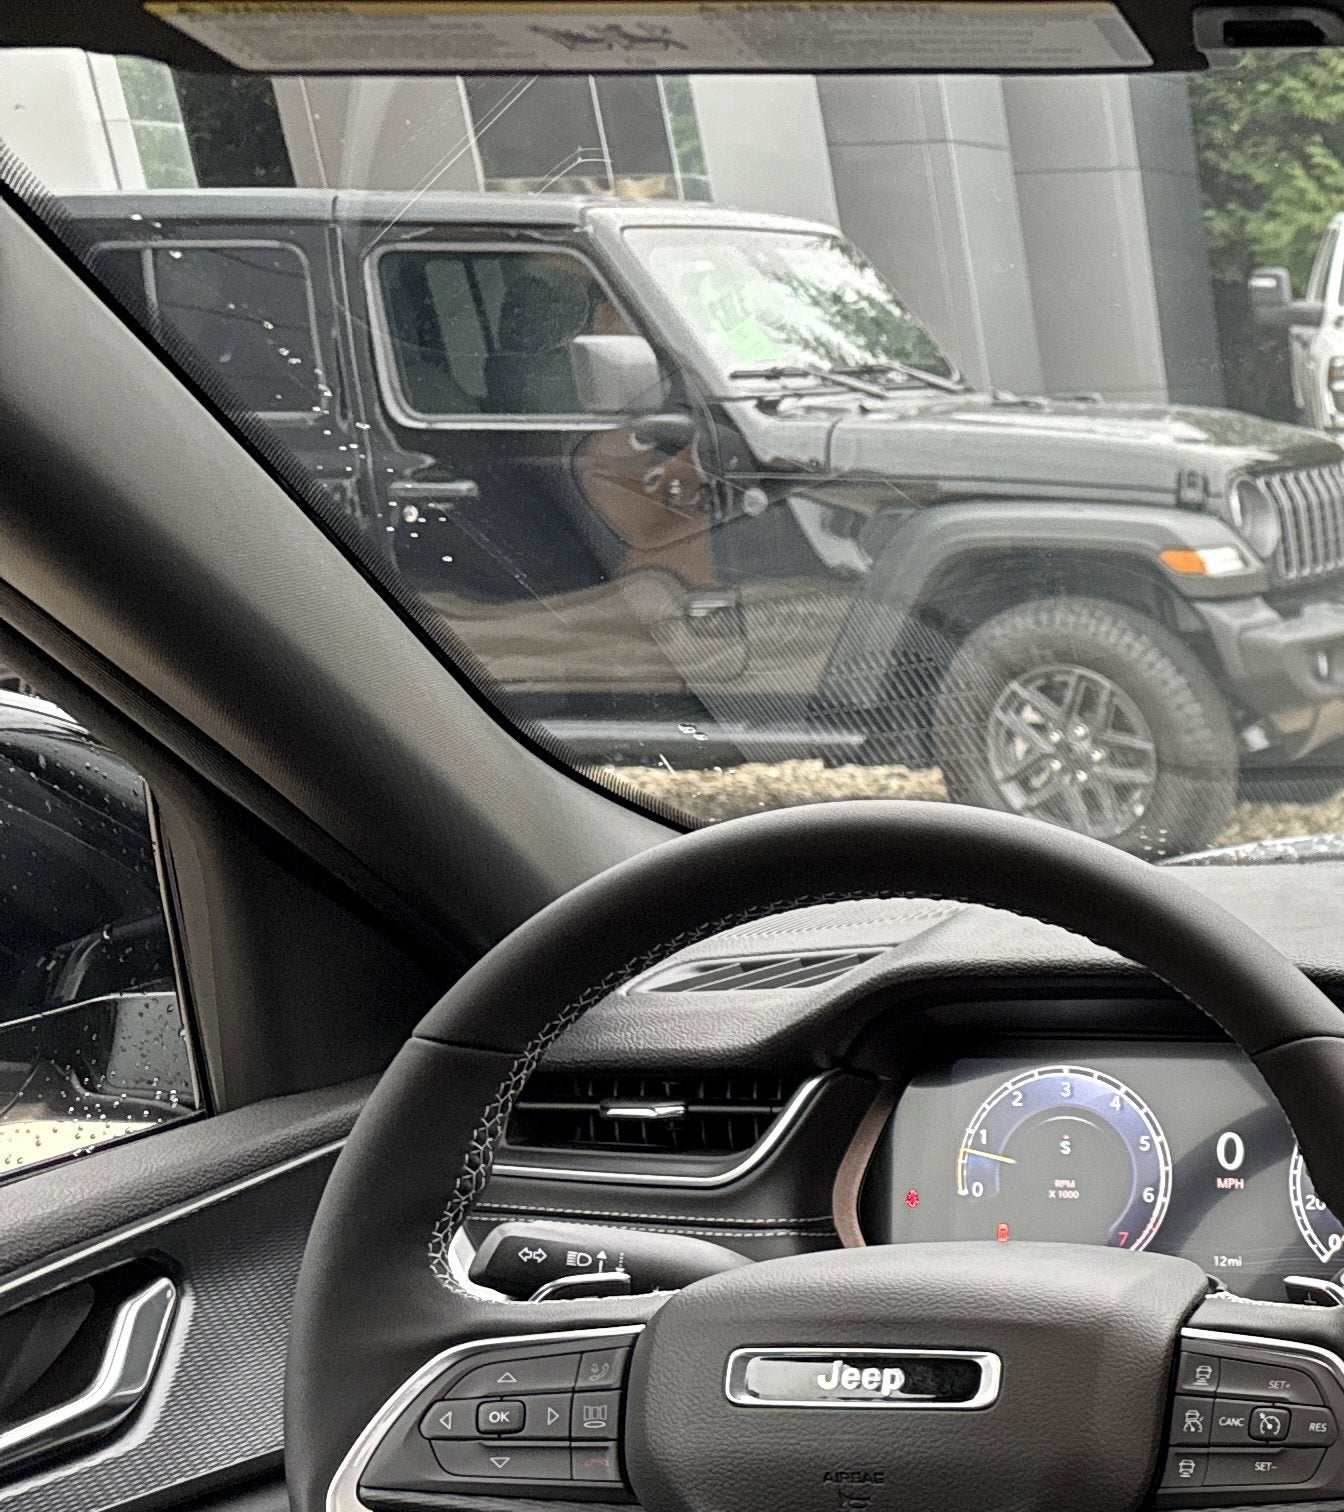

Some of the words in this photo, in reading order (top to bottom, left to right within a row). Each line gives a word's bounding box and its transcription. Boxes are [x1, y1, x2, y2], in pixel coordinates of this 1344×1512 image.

[1060, 1082, 1072, 1098] 3
[1011, 1091, 1024, 1107] 2
[1109, 1095, 1122, 1111] 4
[978, 1129, 988, 1145] 1
[1139, 1136, 1151, 1151] 5
[1216, 1131, 1245, 1171] 0
[971, 1182, 984, 1198] 0
[1053, 1179, 1076, 1188] RPM
[1216, 1177, 1245, 1190] MPH
[1058, 1190, 1080, 1199] 1000
[1142, 1187, 1155, 1203] 6
[1117, 1231, 1130, 1247] 7
[1328, 1234, 1342, 1250] 0
[1213, 1255, 1243, 1268] 12mi
[816, 1360, 906, 1396] Jeep
[488, 1411, 511, 1424] OK
[1218, 1416, 1246, 1427] CANC
[1308, 1422, 1328, 1433] RES
[822, 1471, 886, 1485] AIRBAG
